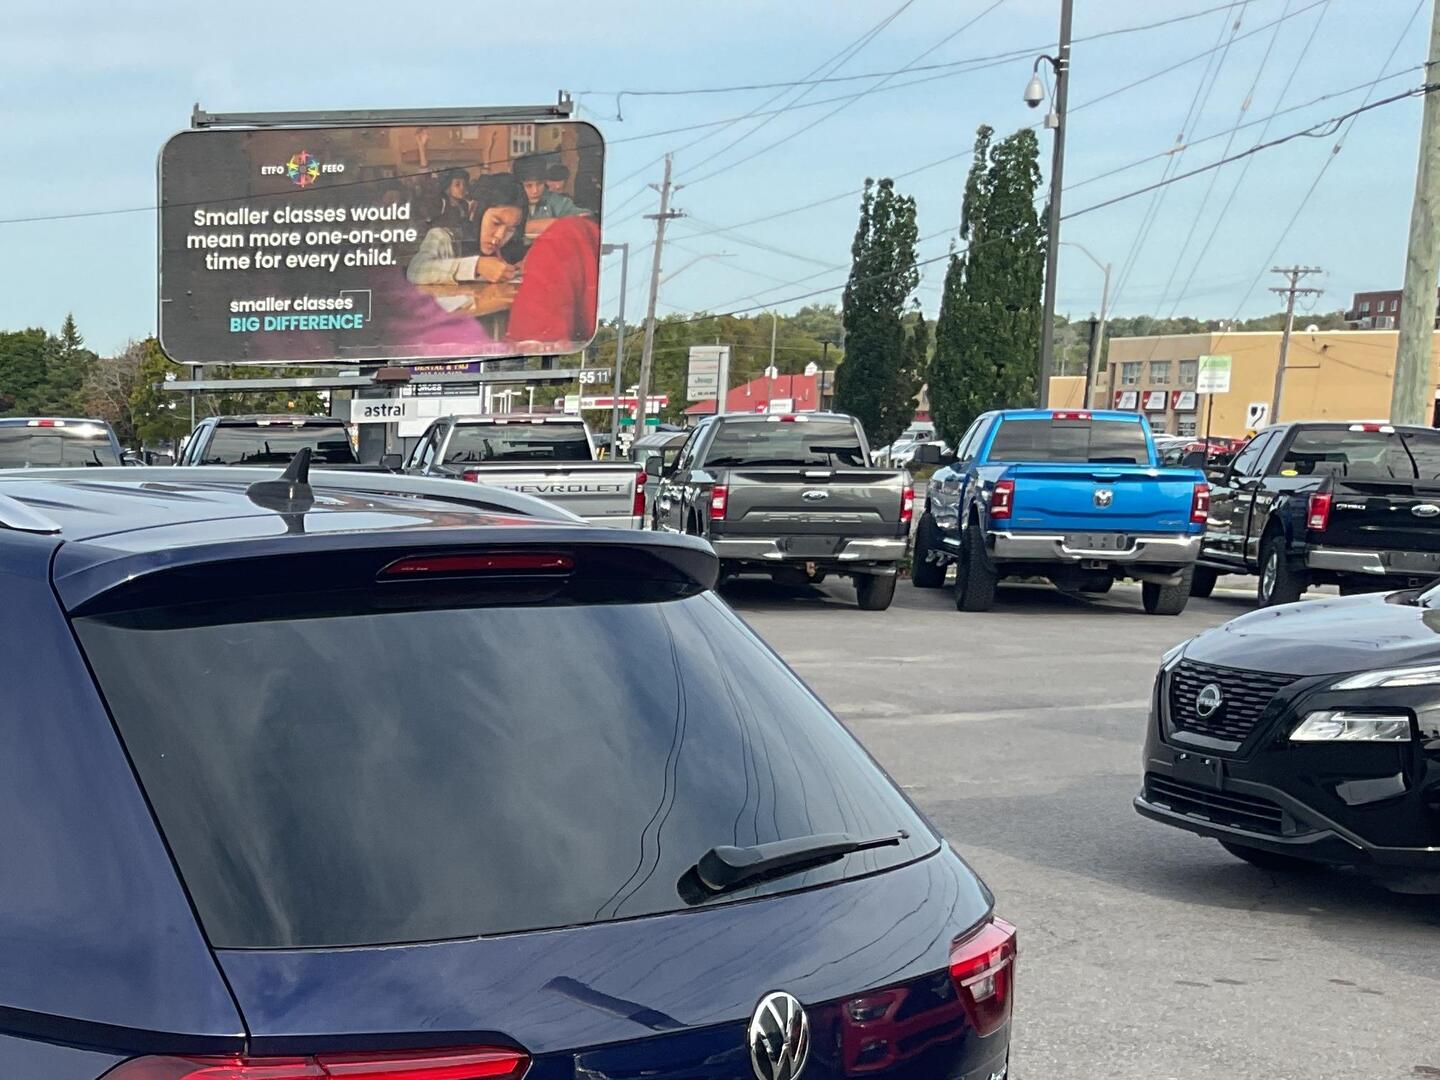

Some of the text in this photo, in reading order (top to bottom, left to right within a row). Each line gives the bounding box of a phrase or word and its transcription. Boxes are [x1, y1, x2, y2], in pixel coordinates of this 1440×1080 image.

[261, 163, 345, 175] ETFO FEEO
[194, 202, 410, 226] Smaller classes would
[187, 228, 417, 249] mean more one-on-one
[205, 248, 397, 272] time for every child.
[230, 296, 353, 313] smaller classes
[230, 314, 364, 332] BIG DIFFERENCE
[364, 402, 406, 417] astral
[503, 484, 625, 493] HEVROLET
